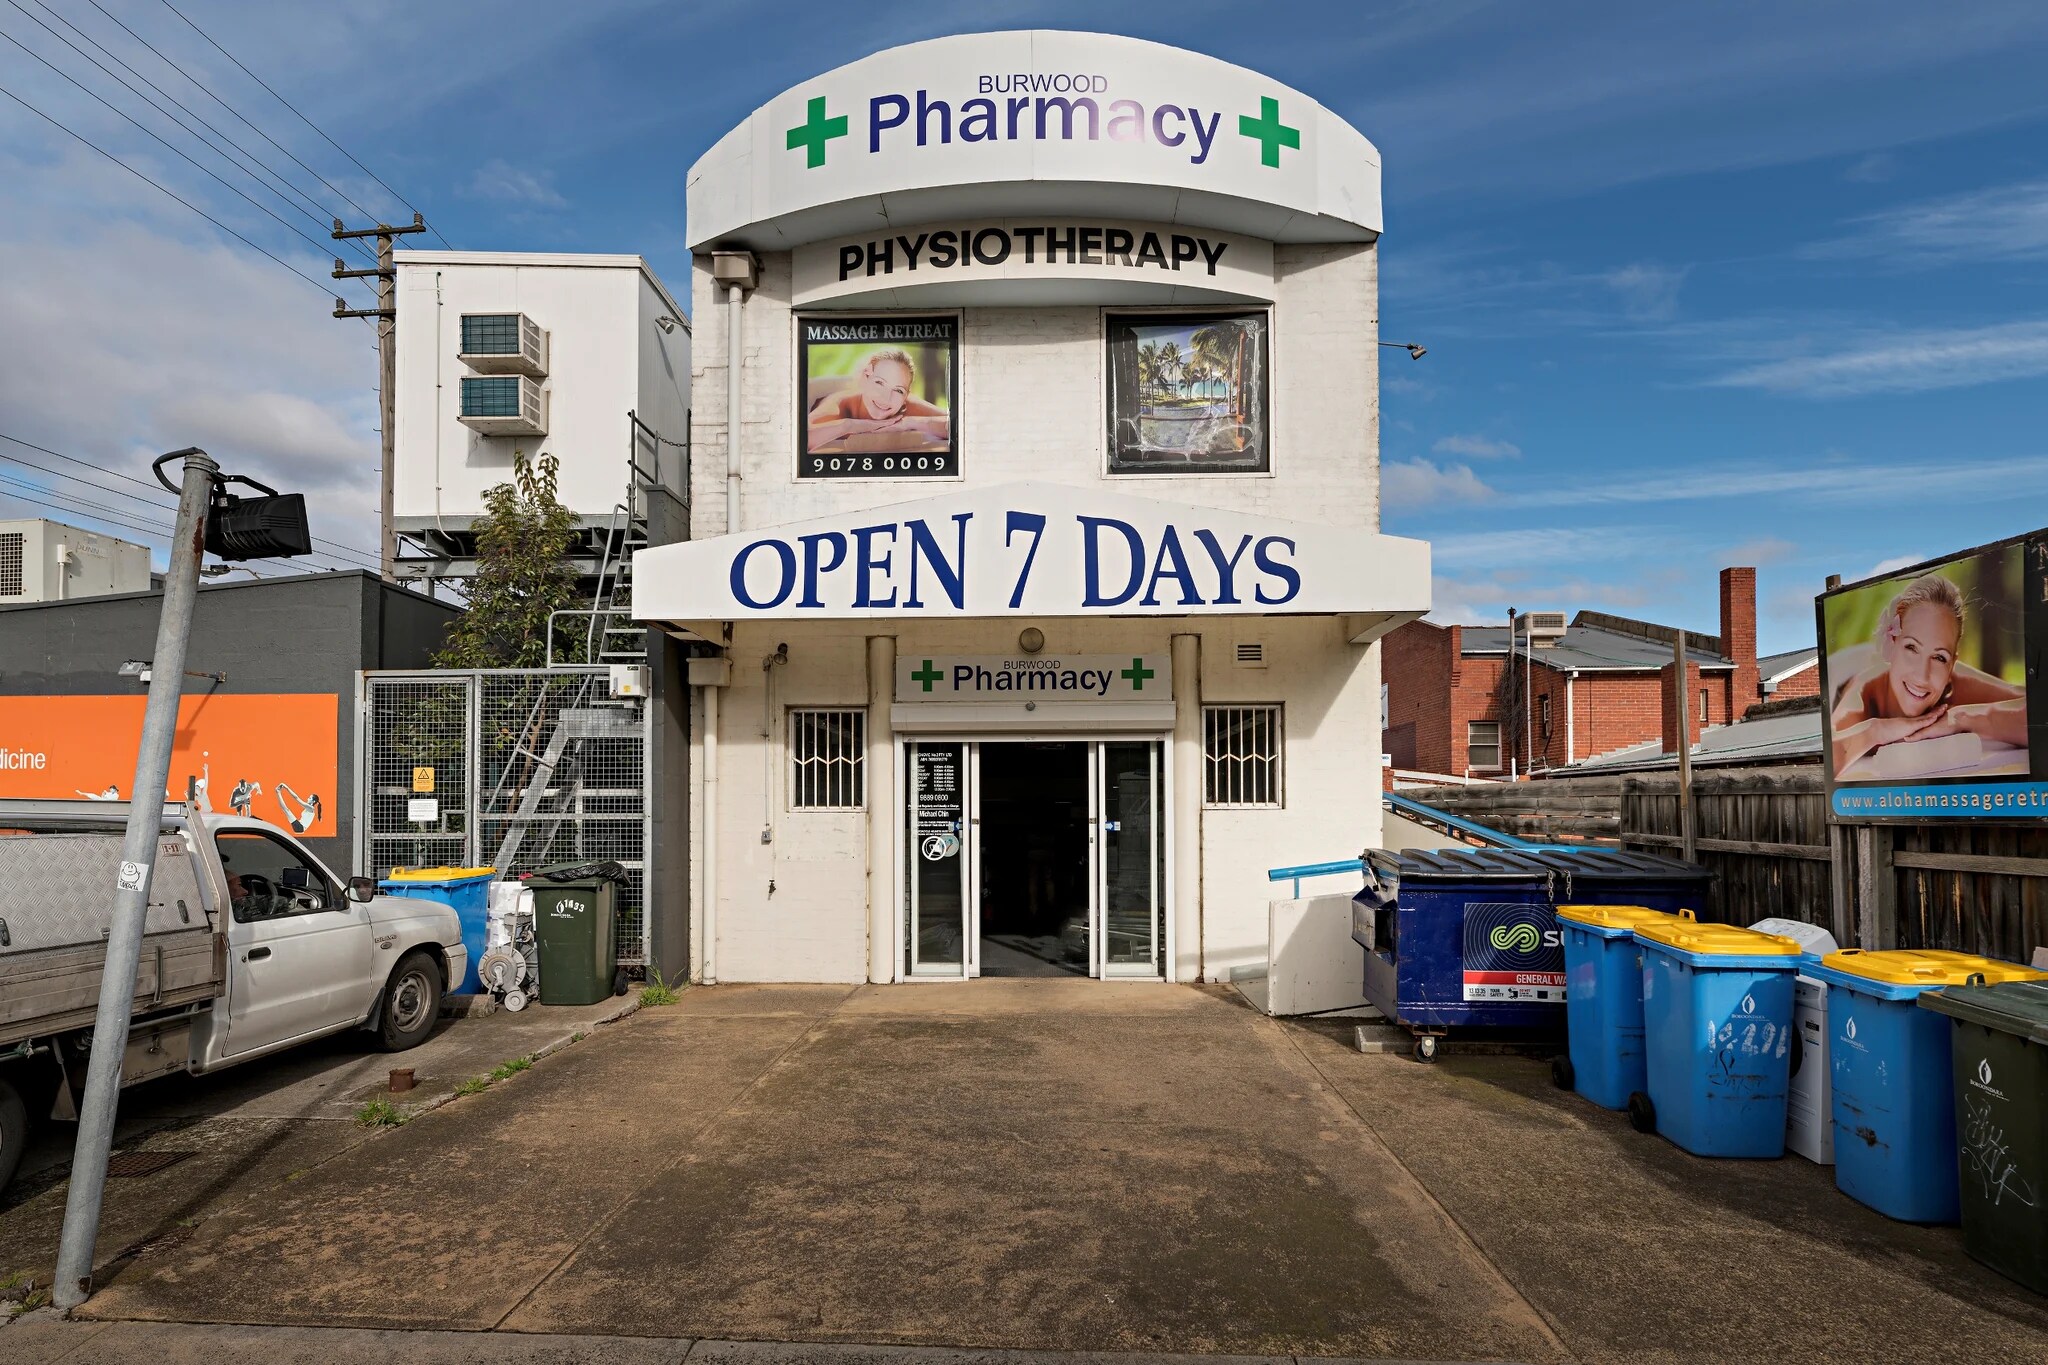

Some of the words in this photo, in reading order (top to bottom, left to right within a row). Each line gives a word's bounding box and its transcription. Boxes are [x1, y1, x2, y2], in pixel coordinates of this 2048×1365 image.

[978, 74, 1109, 95] BURWOOD
[869, 88, 1221, 165] Pharmacy
[838, 226, 1229, 282] PHYSIOTHERAPY
[807, 325, 878, 341] MASSAGE
[884, 324, 952, 339] RETREAT
[813, 458, 873, 472] 9078
[883, 457, 945, 471] 0009
[729, 512, 974, 609] OPEN
[1005, 511, 1046, 609] 7
[1076, 515, 1301, 608] DAYS
[1003, 660, 1061, 670] BURWOOD
[953, 665, 1113, 696] Pharmacy
[1516, 973, 1553, 985] GENERAL
